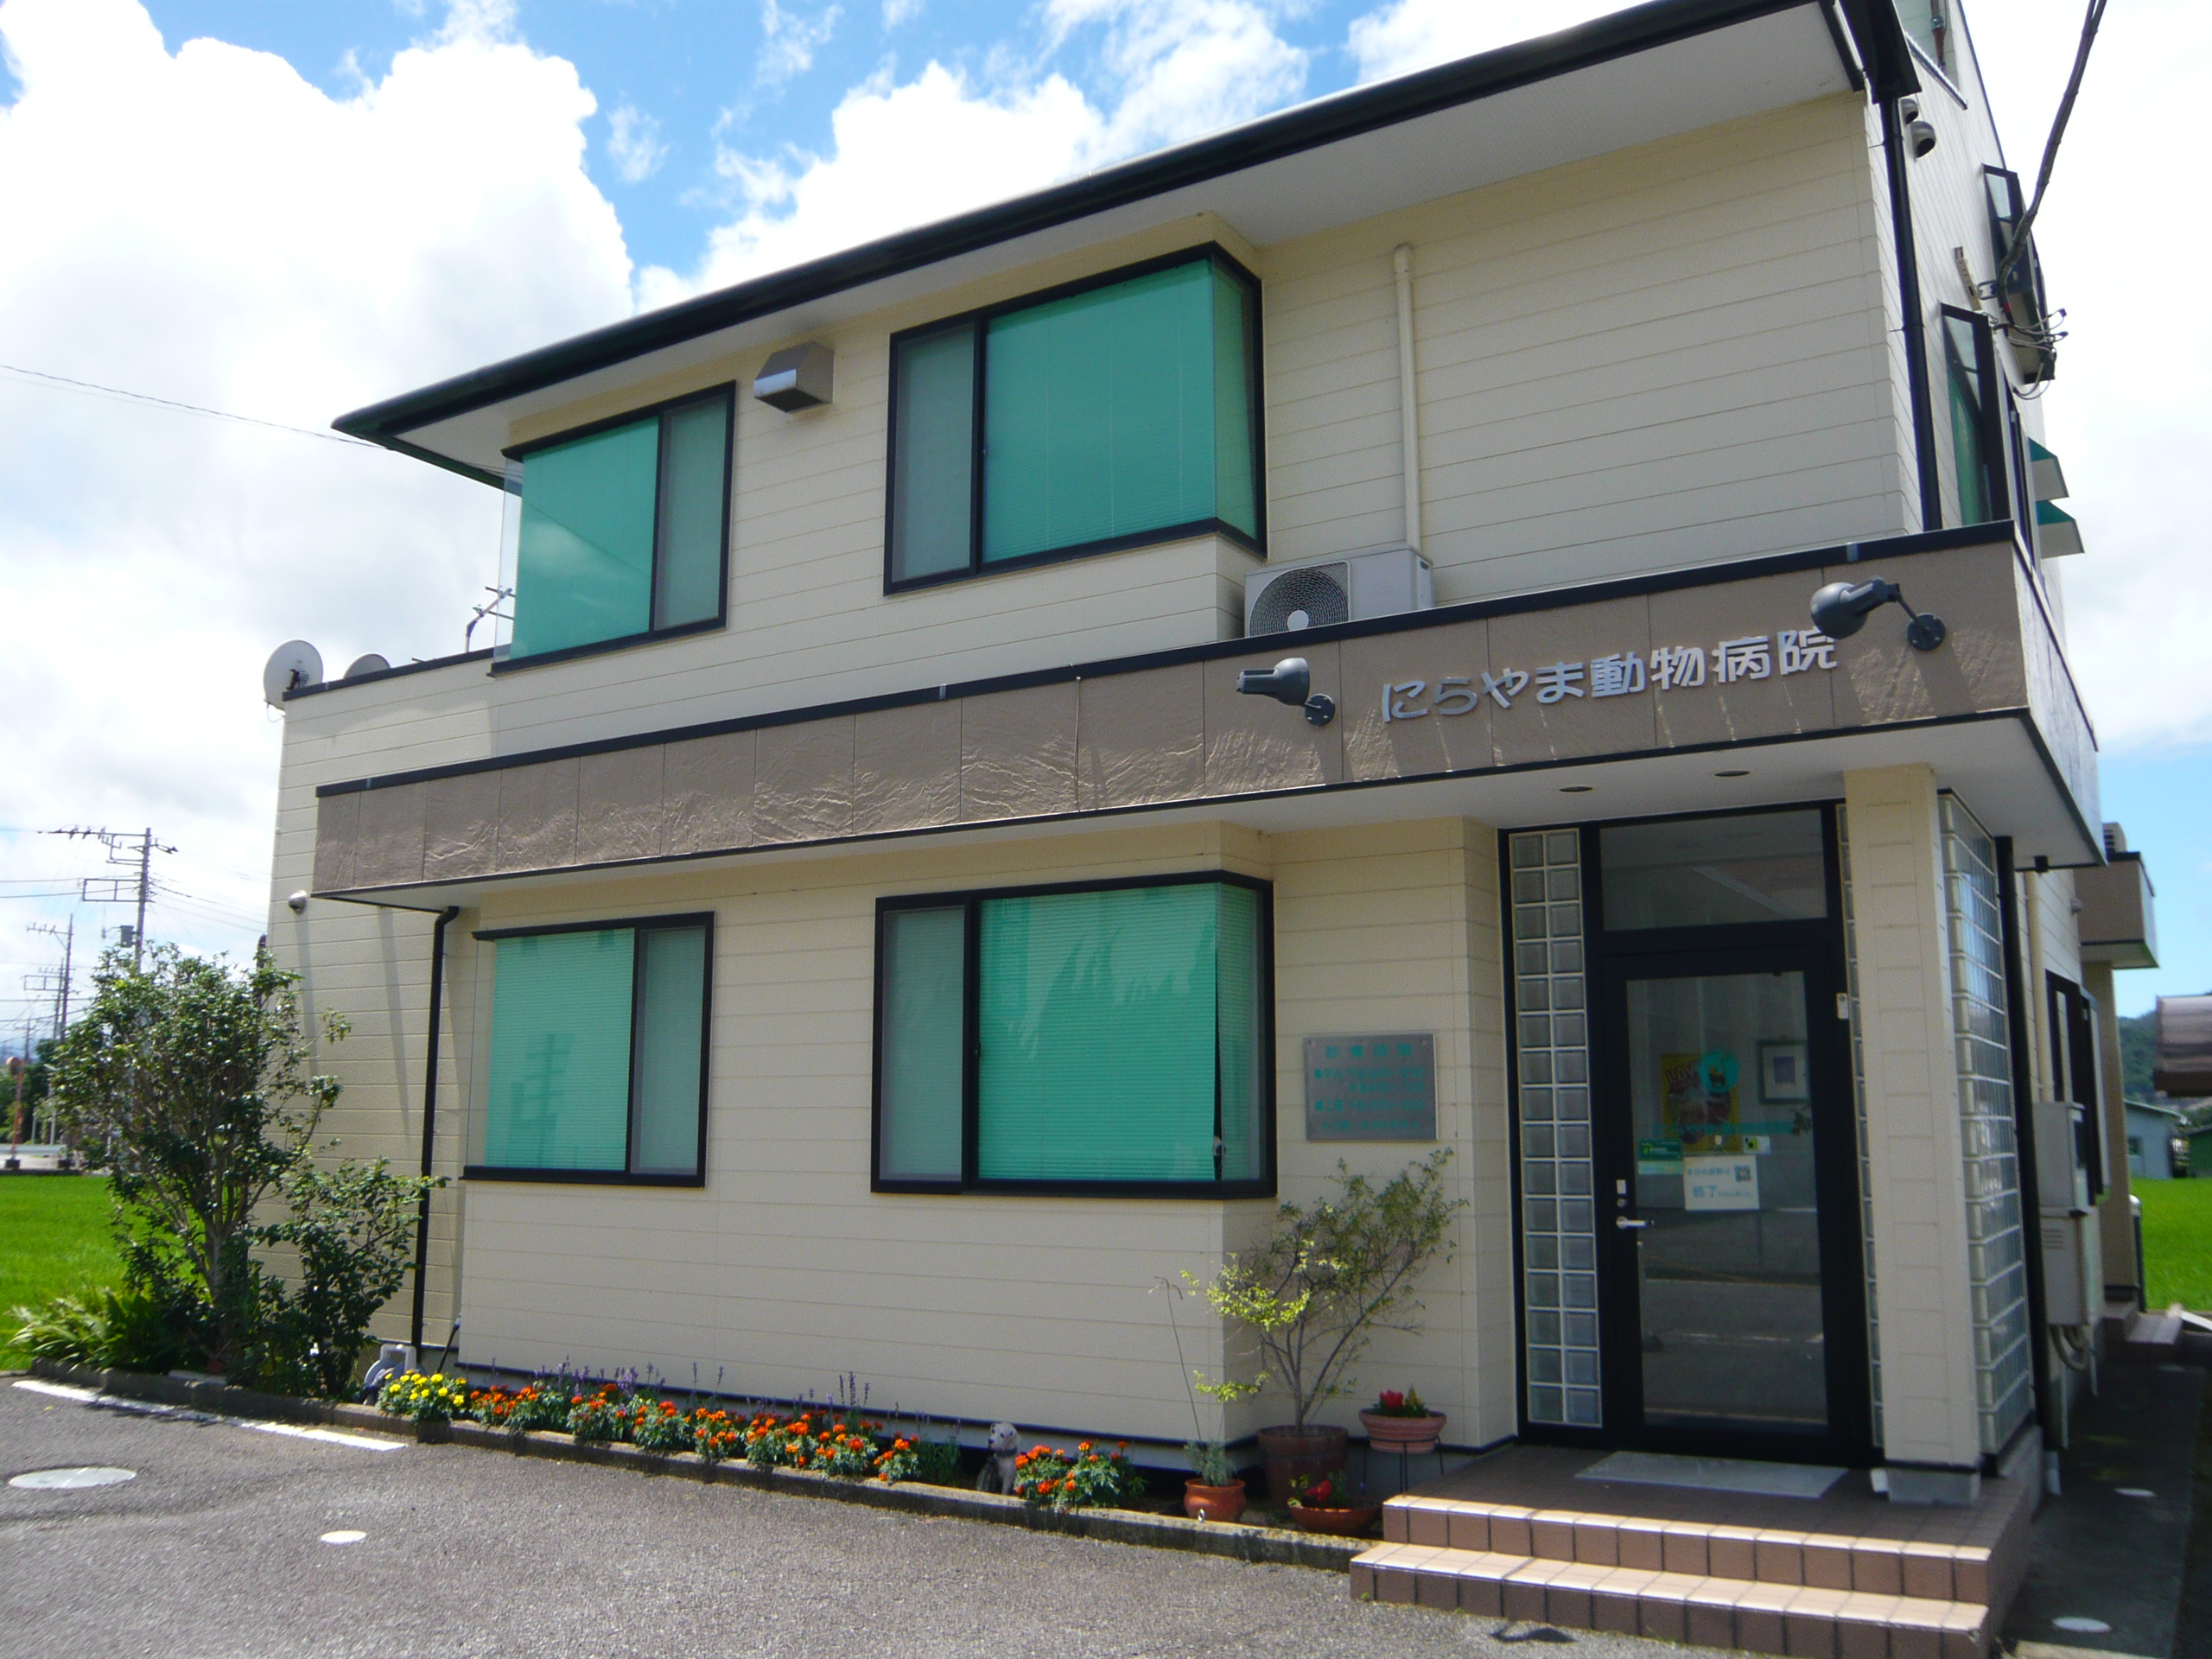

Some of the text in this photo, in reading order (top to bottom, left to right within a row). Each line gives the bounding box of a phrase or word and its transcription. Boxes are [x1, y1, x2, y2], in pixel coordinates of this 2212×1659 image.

[1382, 629, 1838, 722] にらやま動物病院
